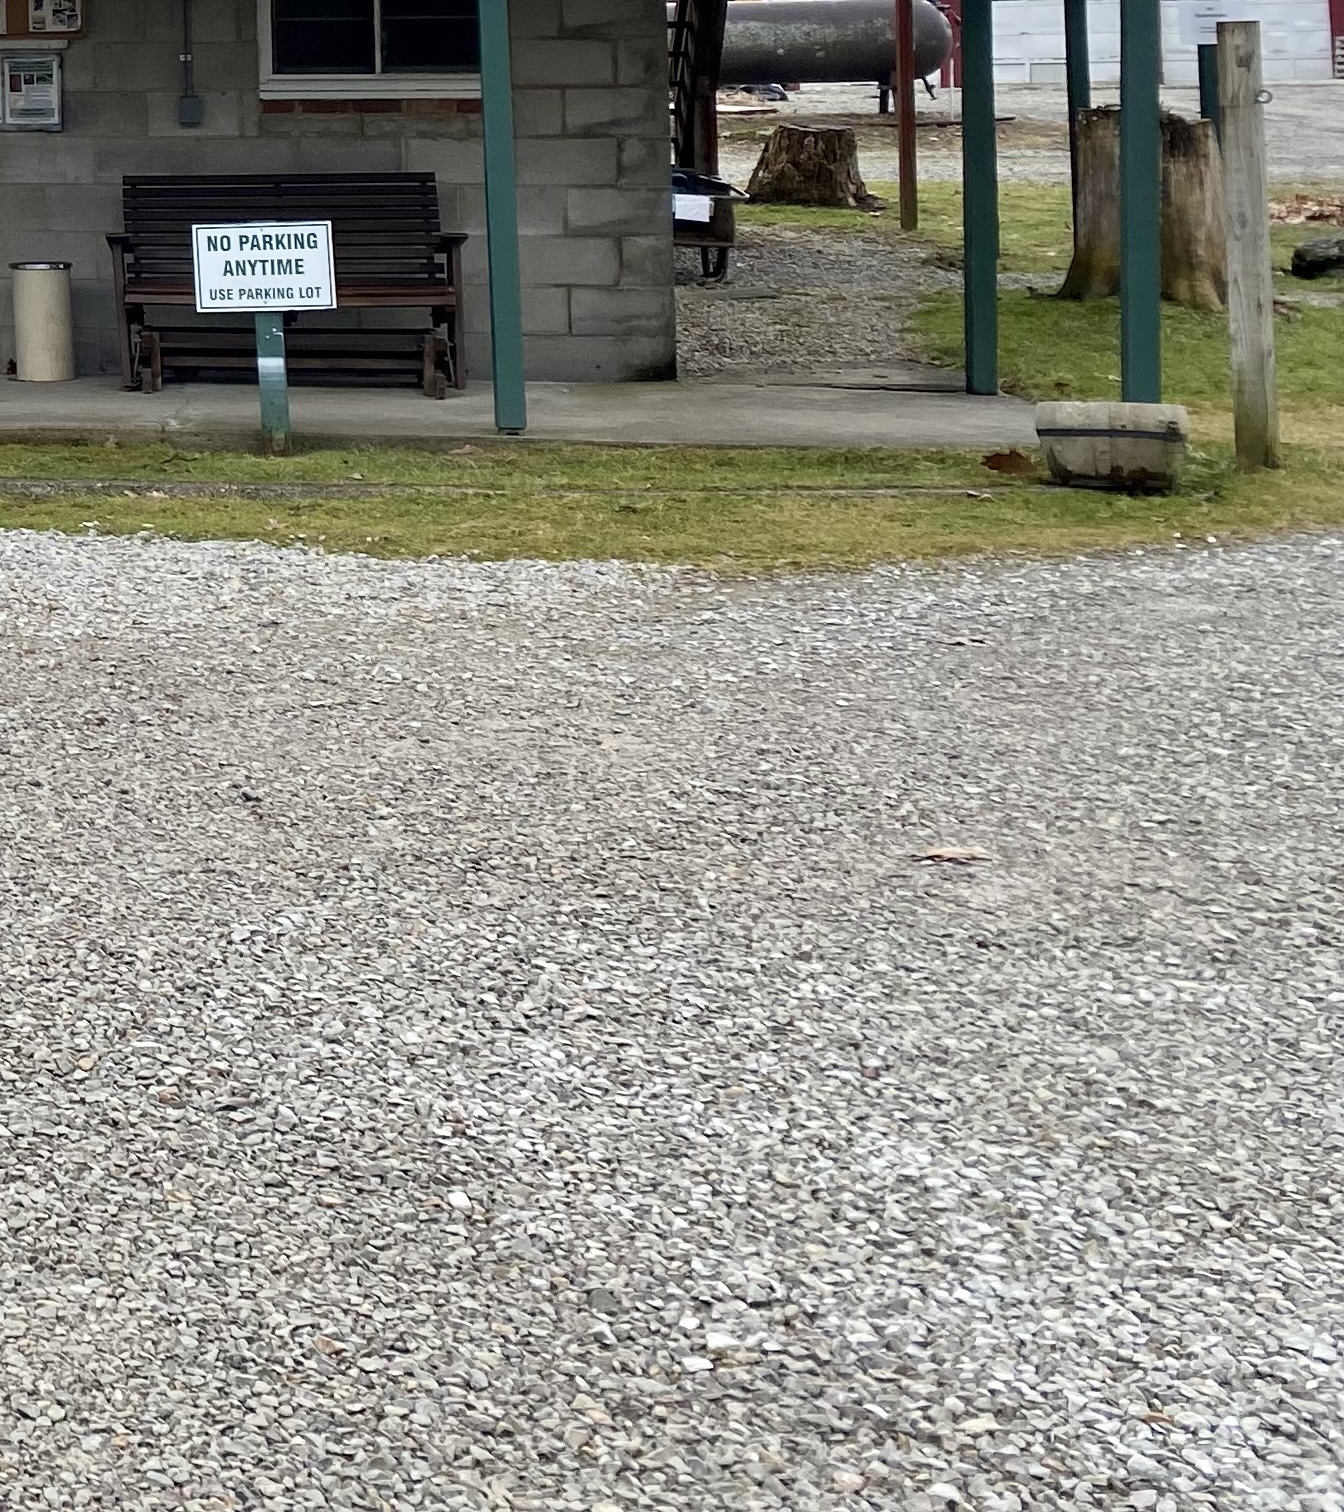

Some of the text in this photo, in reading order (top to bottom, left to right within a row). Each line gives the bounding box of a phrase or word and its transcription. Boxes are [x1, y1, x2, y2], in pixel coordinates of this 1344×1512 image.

[207, 232, 318, 252] NO PARKING
[223, 258, 305, 277] ANYTIME
[209, 286, 322, 301] USE PARKING LOT
